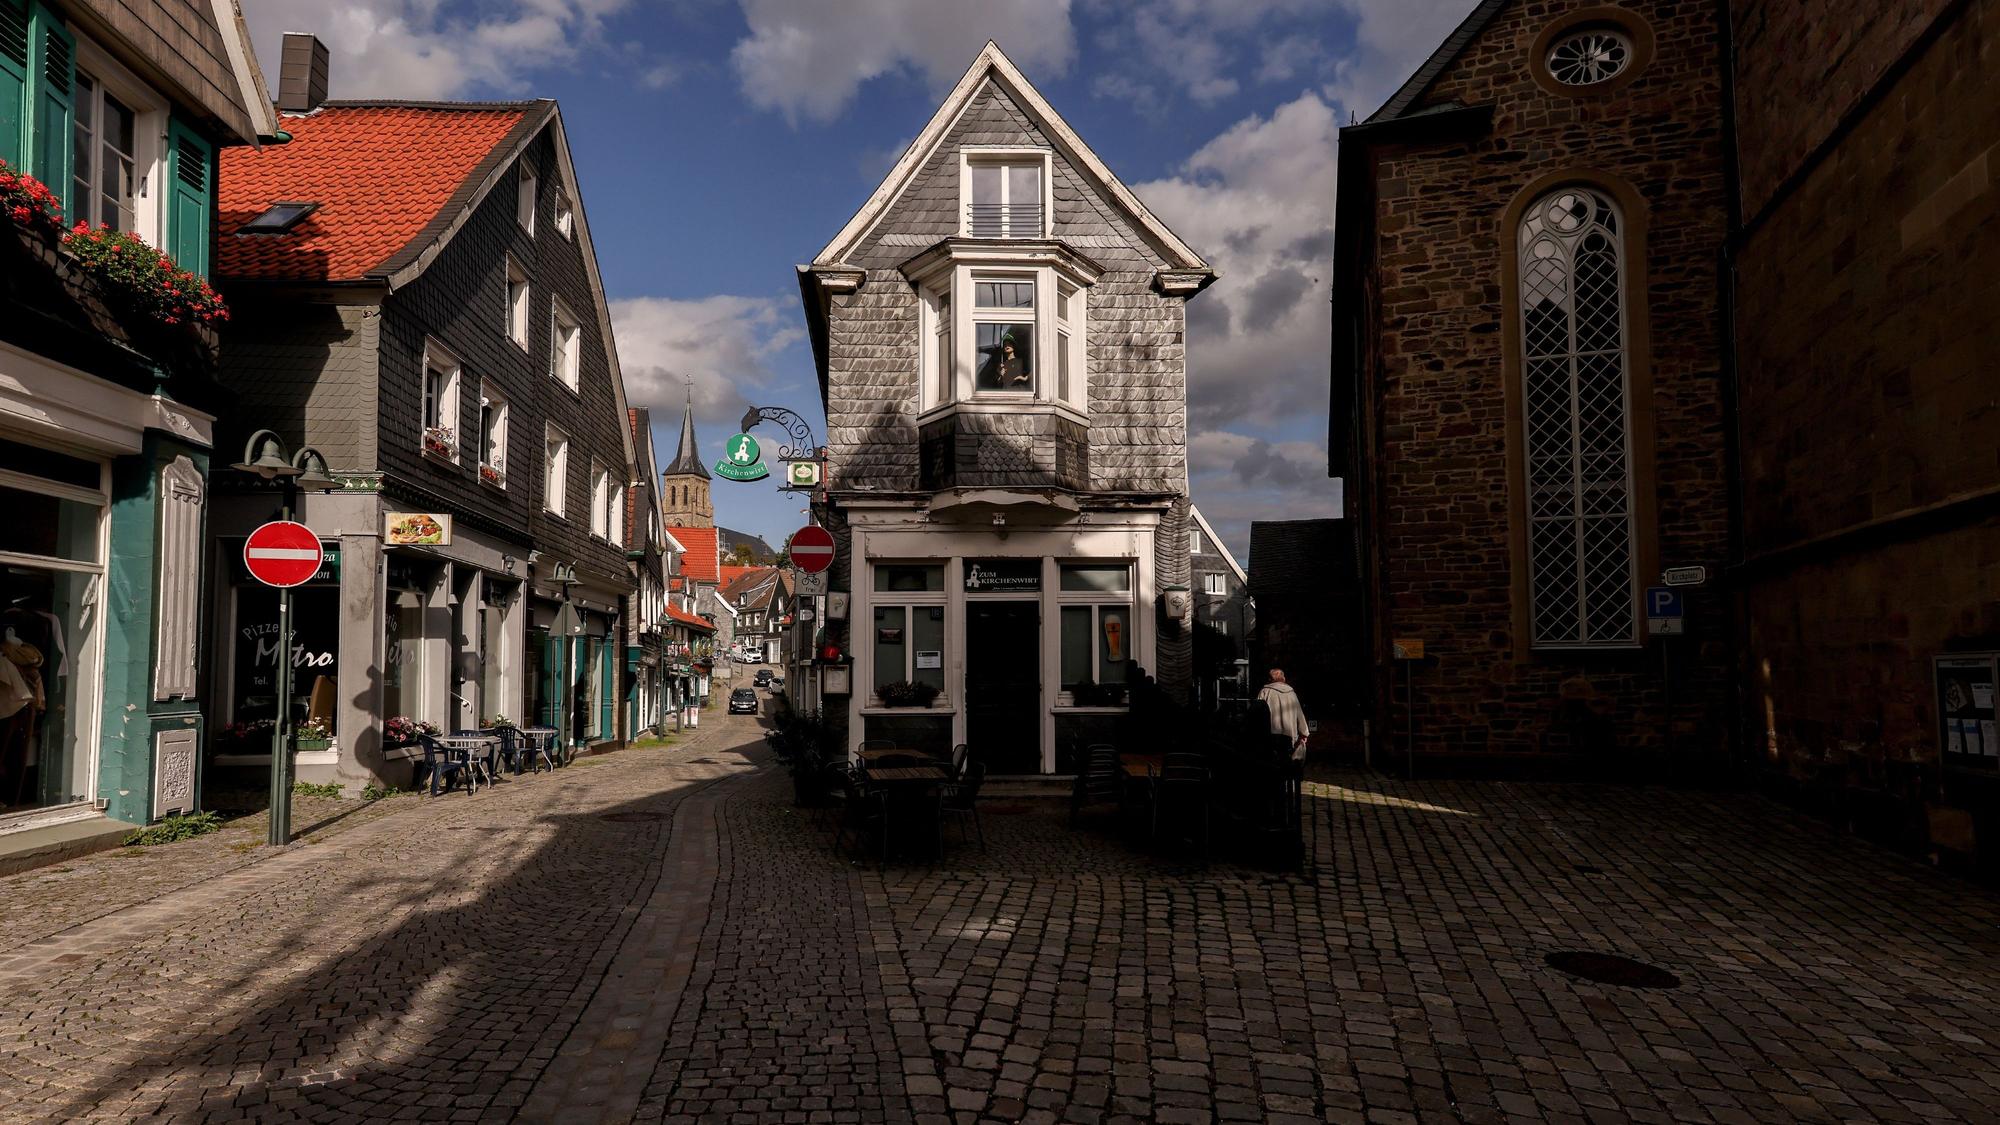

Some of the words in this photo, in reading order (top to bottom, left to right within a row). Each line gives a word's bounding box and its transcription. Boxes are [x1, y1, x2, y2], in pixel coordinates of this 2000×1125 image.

[718, 463, 765, 476] Kirchenwirt
[1655, 592, 1674, 614] P
[255, 637, 334, 668] Mtro
